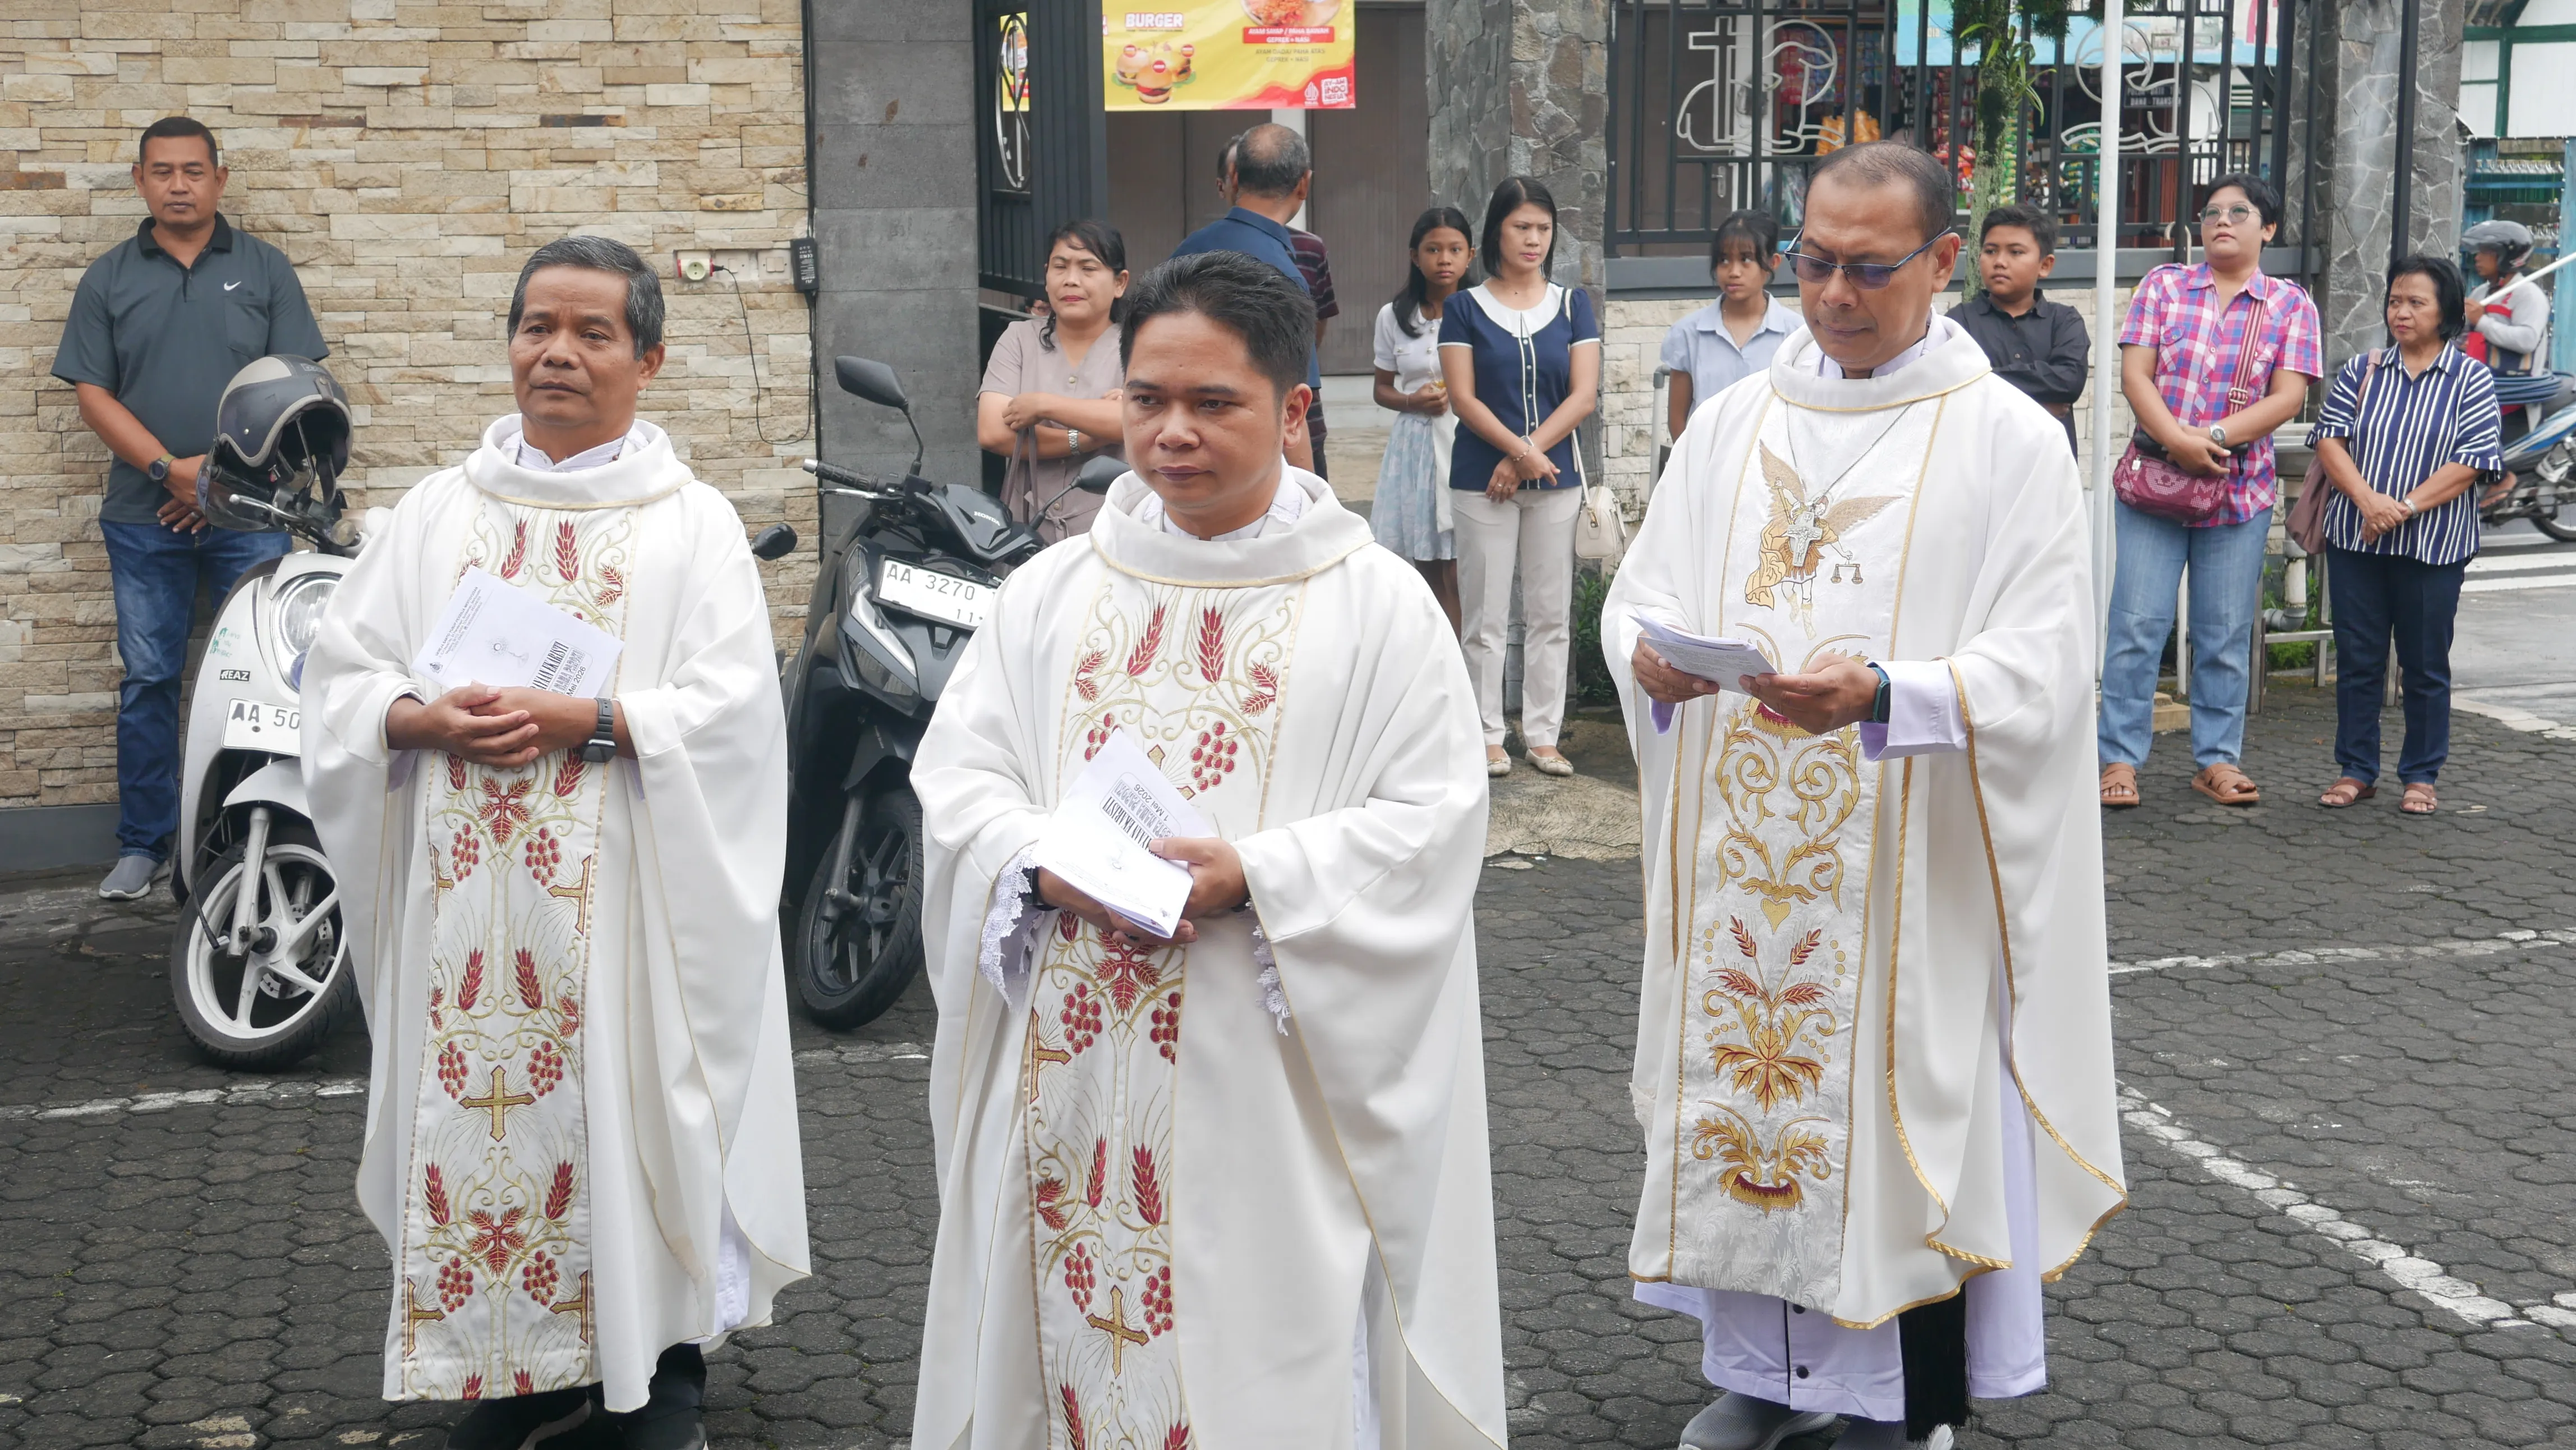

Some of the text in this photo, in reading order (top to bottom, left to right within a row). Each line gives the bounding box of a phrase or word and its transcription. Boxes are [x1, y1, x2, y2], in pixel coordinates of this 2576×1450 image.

[1125, 13, 1184, 27] BURGER
[1324, 85, 1346, 94] INDO
[974, 511, 1000, 526] HONDA
[887, 564, 975, 600] AA 3270
[542, 641, 569, 673] EKARISTI
[553, 671, 572, 690] NAMA
[563, 649, 584, 674] PAROKI
[567, 666, 586, 696] Mei 2026
[232, 703, 260, 723] AA
[1134, 783, 1152, 803] 2026
[1101, 796, 1135, 833] EKARISTI
[1114, 781, 1174, 839] ESTA NAMA PAROKI
[1149, 801, 1165, 816] Mei
